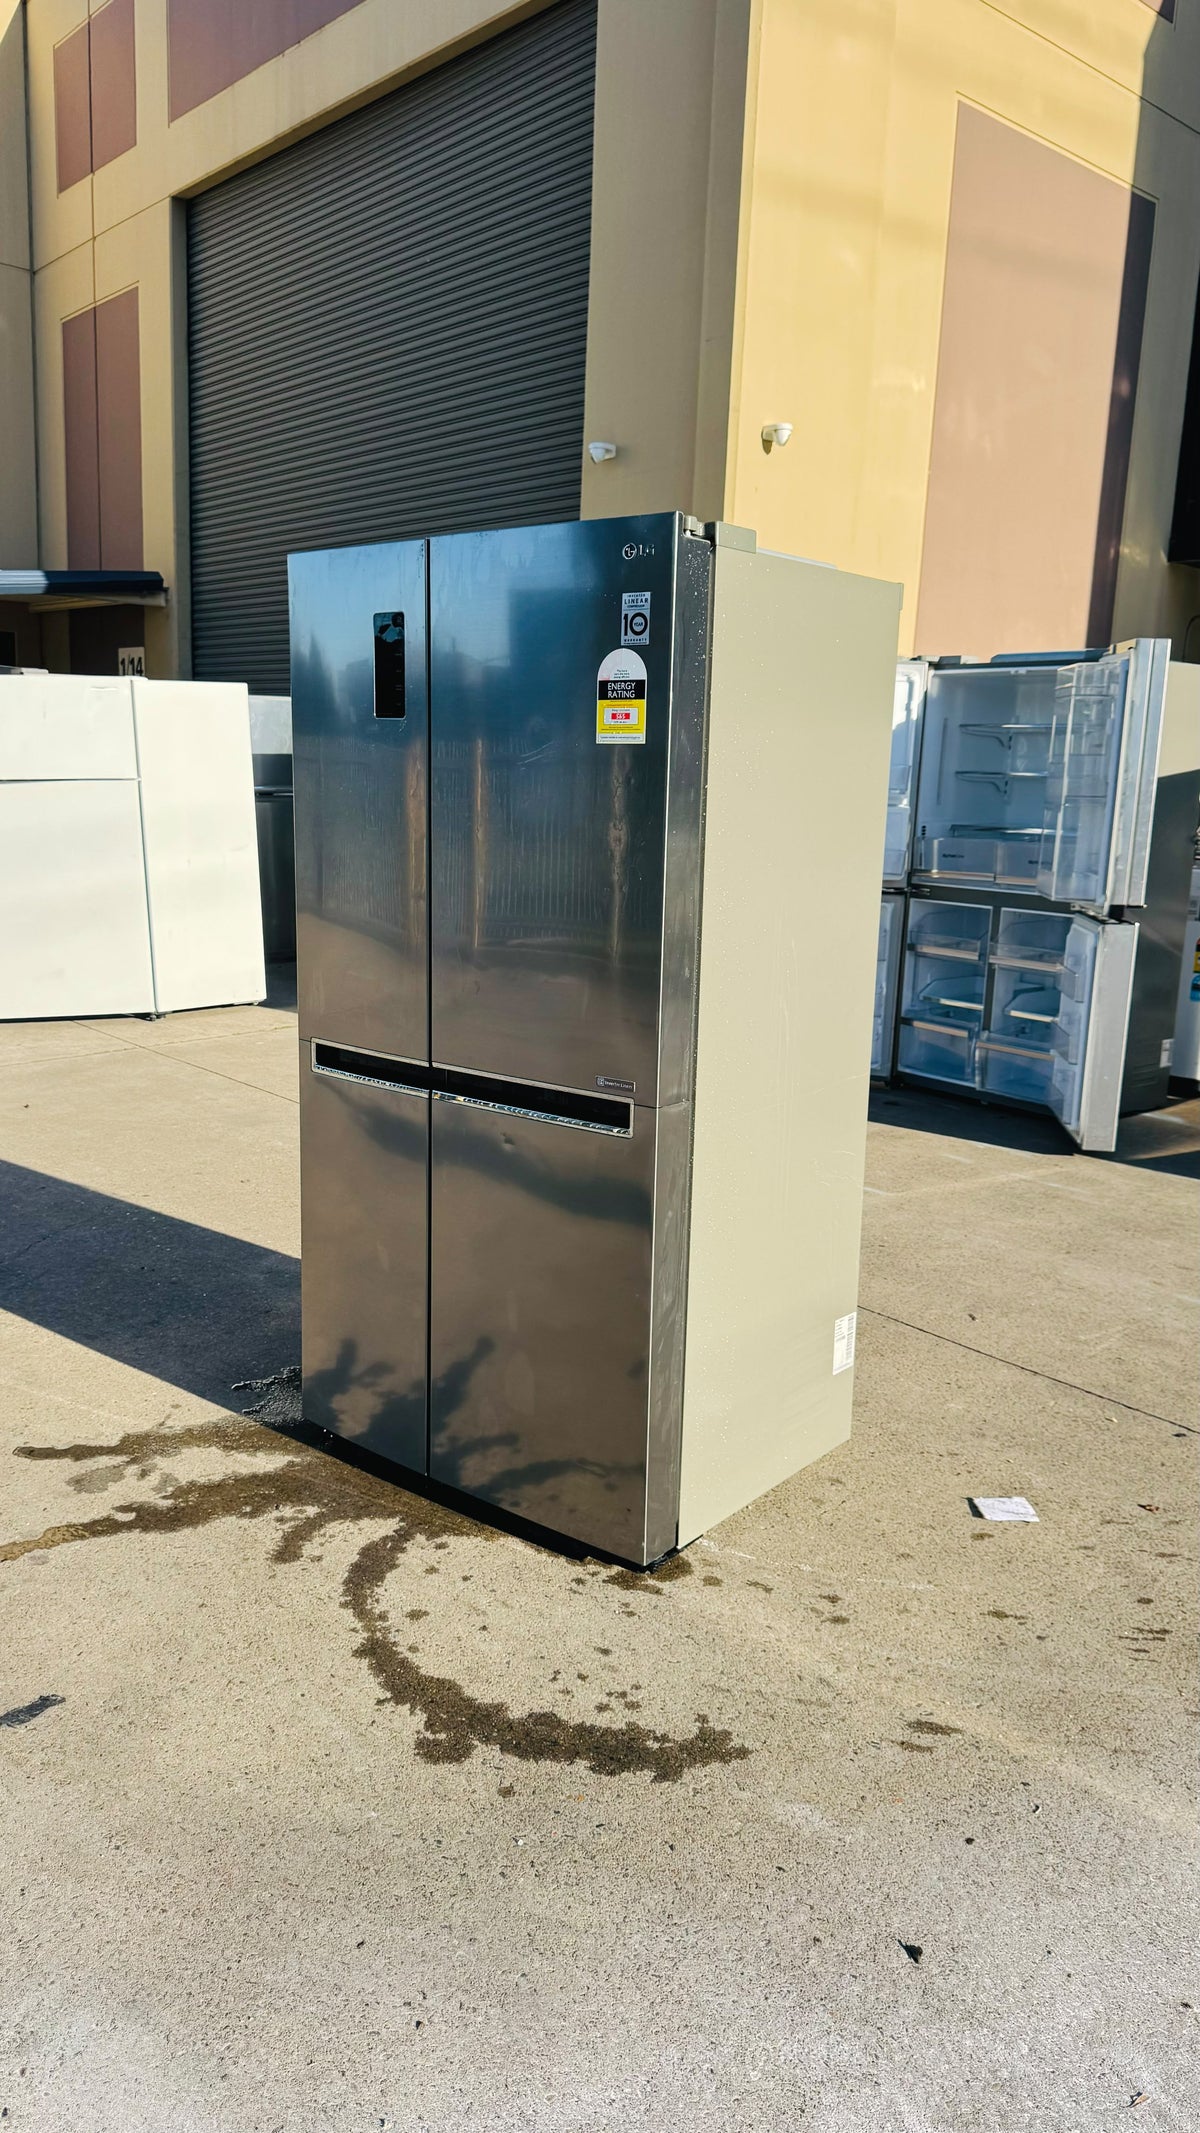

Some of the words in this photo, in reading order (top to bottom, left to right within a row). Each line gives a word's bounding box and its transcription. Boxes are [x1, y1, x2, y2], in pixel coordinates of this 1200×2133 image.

[623, 612, 649, 636] 10
[120, 653, 144, 676] 1/14
[607, 682, 636, 691] ENERGY
[607, 690, 636, 699] RATING
